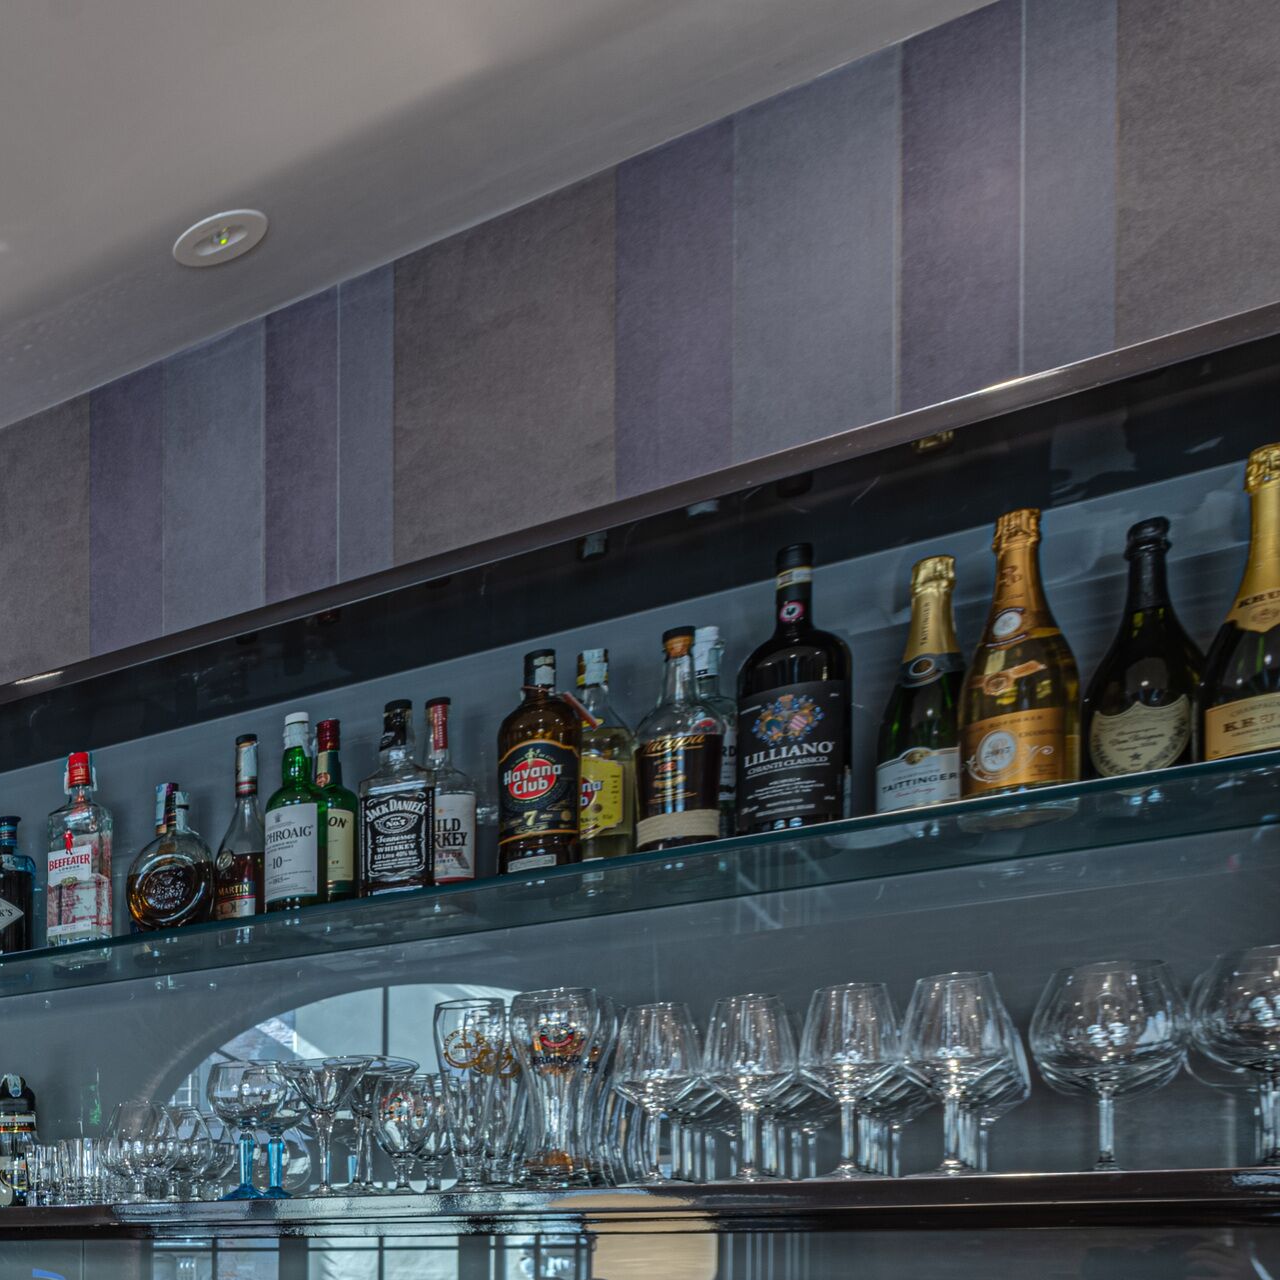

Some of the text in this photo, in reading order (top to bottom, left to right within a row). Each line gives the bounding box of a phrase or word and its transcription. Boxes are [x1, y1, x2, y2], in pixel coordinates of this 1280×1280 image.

[1237, 588, 1280, 609] KRU
[1222, 711, 1280, 733] KRU
[744, 741, 833, 769] LILLIANO
[784, 755, 829, 768] CLASSICO
[504, 763, 563, 785] Havana
[882, 771, 958, 793] TAITTINGER
[513, 778, 548, 796] Club
[366, 799, 428, 822] JACK DANIEL'S
[524, 810, 538, 826] 7
[436, 818, 461, 832] ILD
[265, 826, 312, 846] PHROAIG
[376, 833, 417, 843] Tennessee
[434, 832, 468, 849] RKEY
[377, 842, 416, 853] WHISKEY
[48, 854, 91, 872] BEEFEATER
[272, 856, 283, 870] 10
[218, 883, 249, 897] MARTIN
